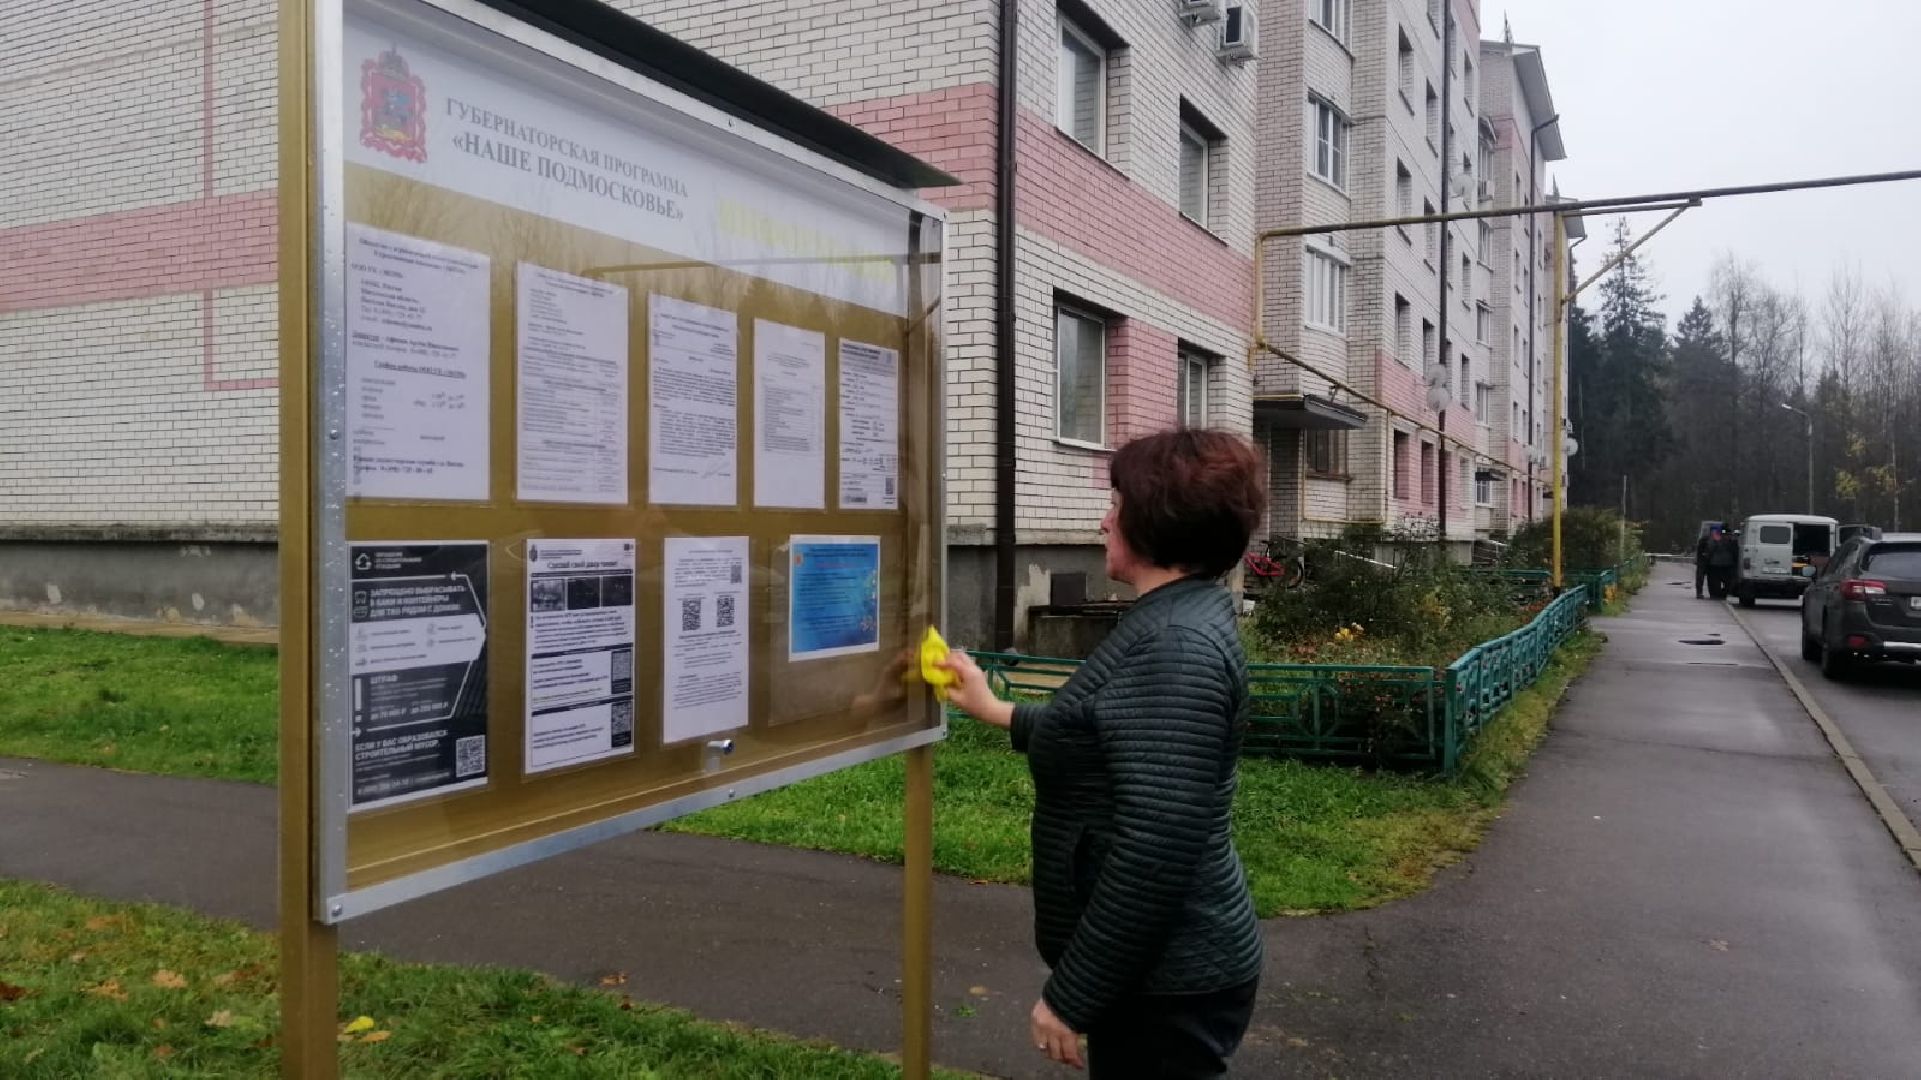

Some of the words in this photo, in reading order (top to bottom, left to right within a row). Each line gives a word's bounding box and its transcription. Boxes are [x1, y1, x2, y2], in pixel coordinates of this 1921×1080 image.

[446, 97, 600, 167] ГУБЕРНАТОРСКАЯ
[603, 153, 689, 199] ПРОГРАММА
[452, 132, 532, 173] «НАШЕ
[537, 155, 684, 222] ПОДМОСКОВЬЕ»
